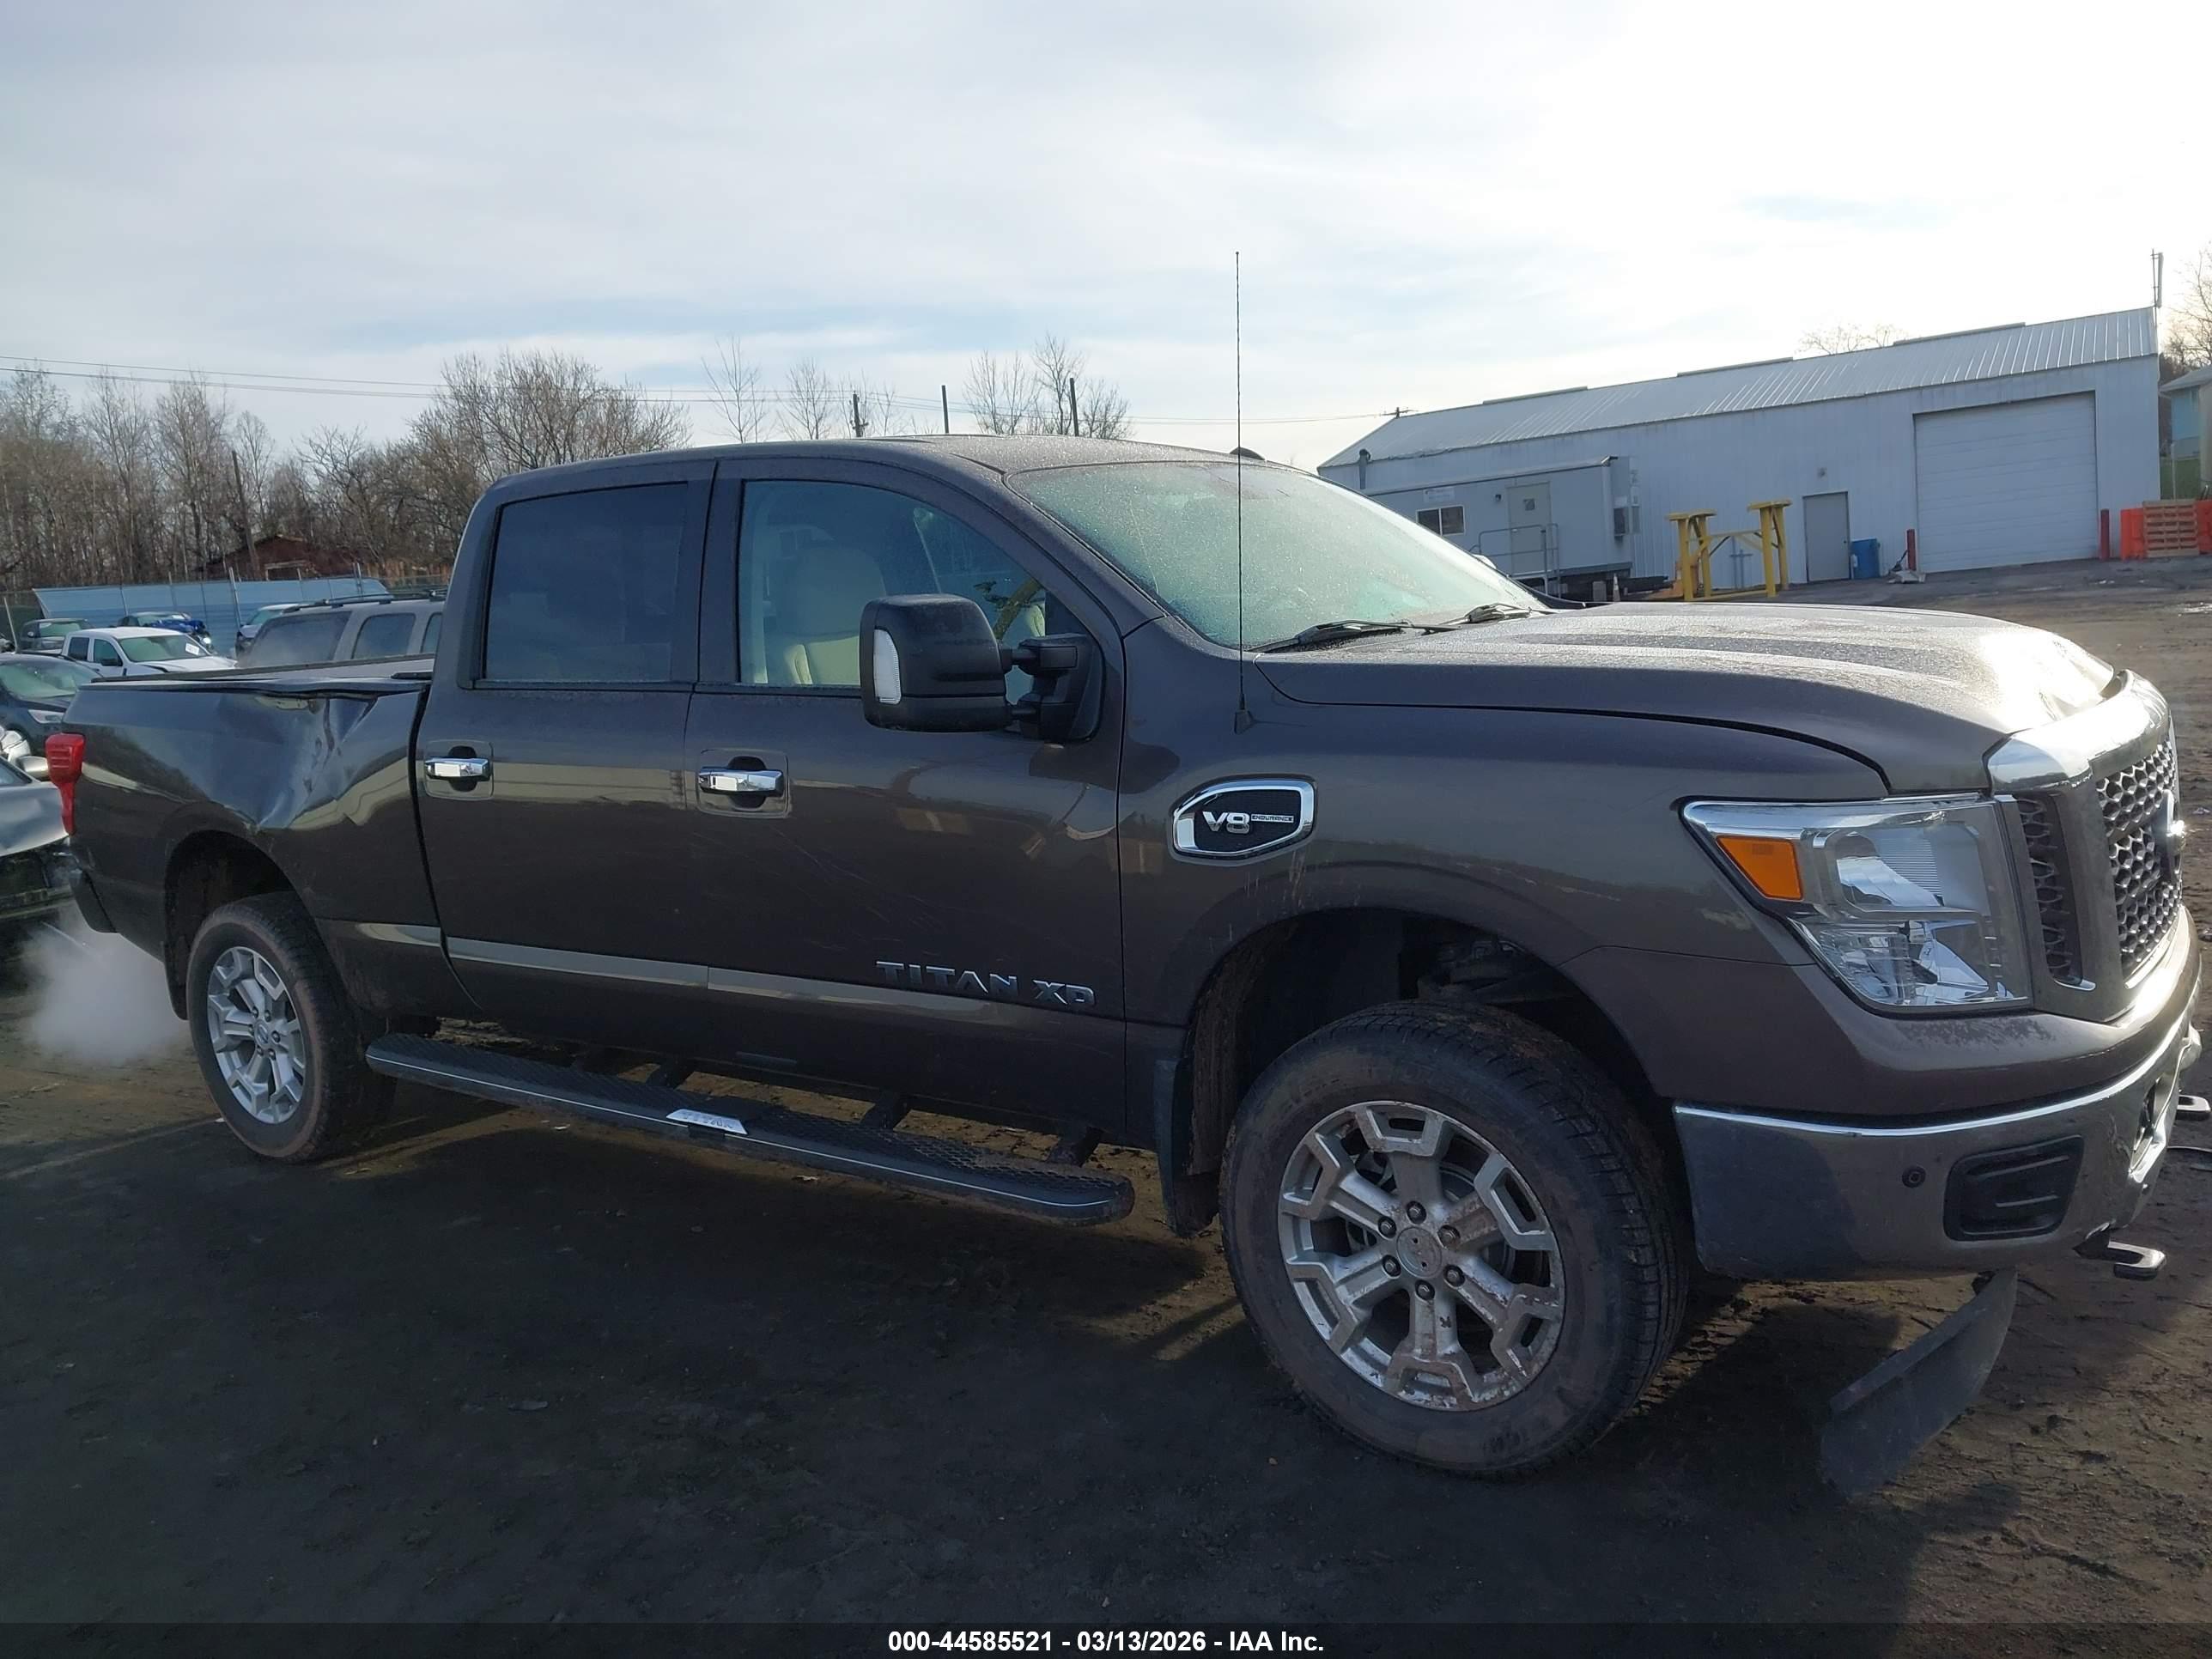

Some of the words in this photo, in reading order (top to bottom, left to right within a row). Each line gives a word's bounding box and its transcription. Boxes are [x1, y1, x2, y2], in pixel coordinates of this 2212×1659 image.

[1202, 811, 1250, 834] V8
[1251, 814, 1294, 823] ENDURANCE
[876, 961, 1019, 997] TITAN
[1033, 980, 1097, 1007] XD
